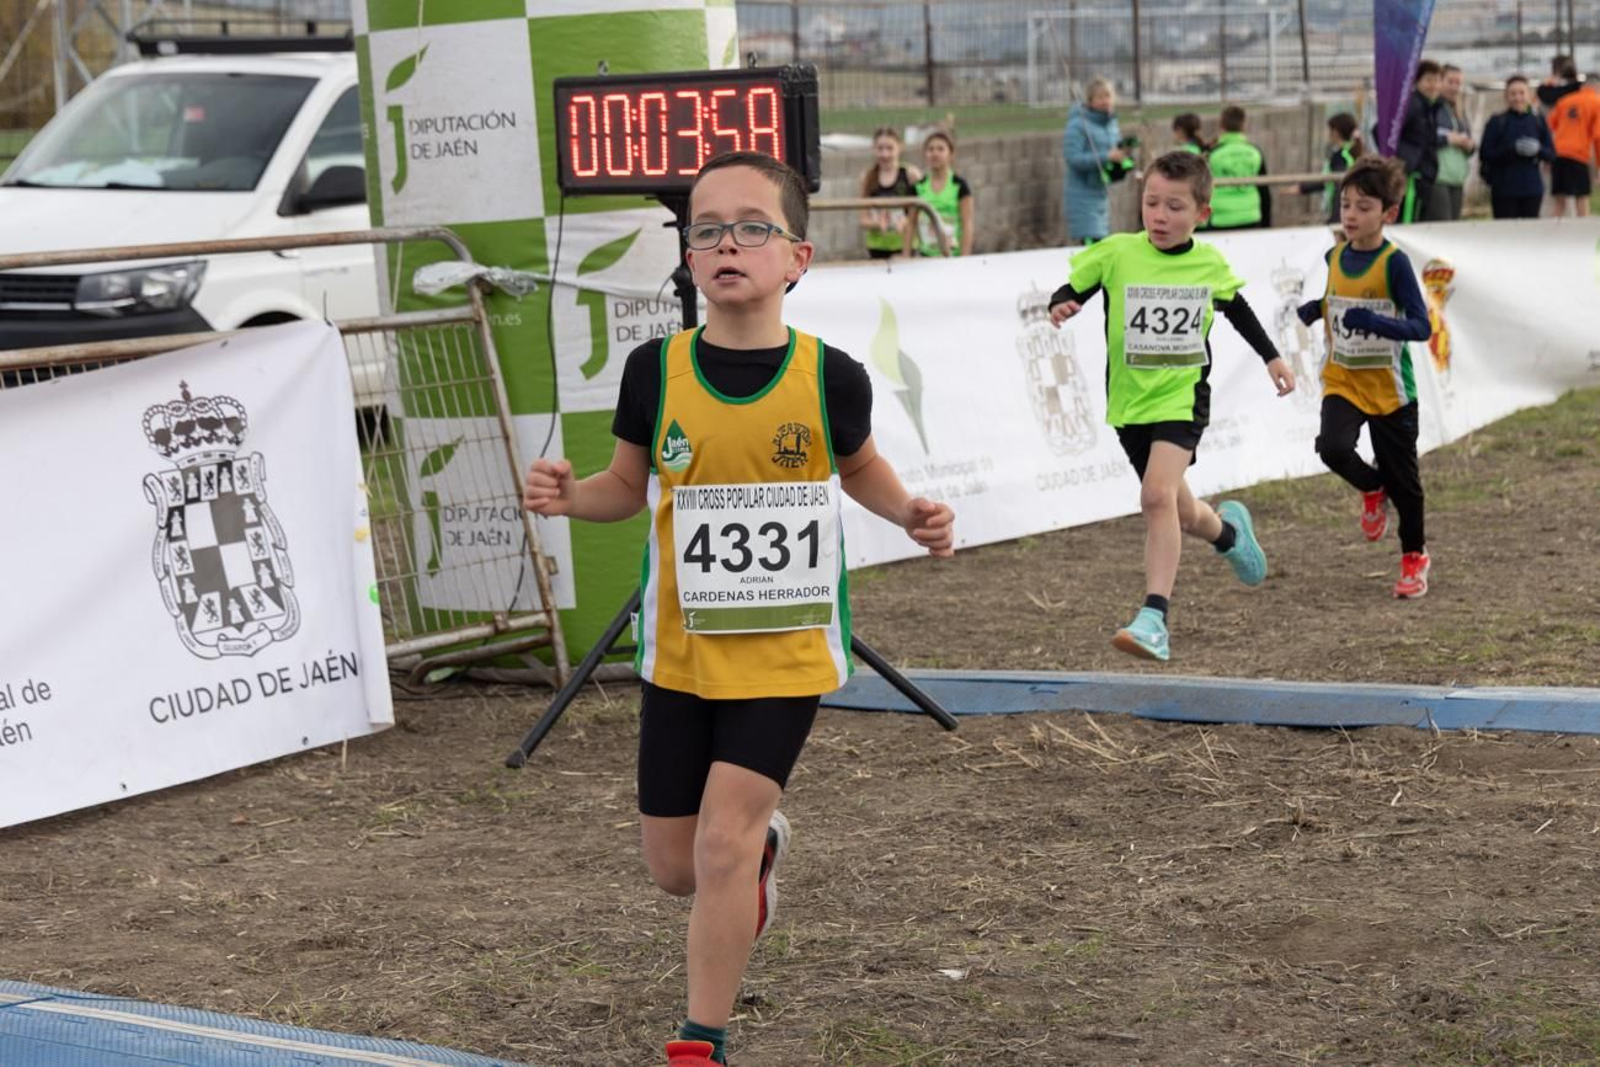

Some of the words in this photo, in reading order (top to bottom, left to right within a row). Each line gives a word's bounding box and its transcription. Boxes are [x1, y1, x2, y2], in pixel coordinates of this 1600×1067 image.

[409, 109, 516, 135] DIPUTACIÓN
[411, 143, 432, 160] DE
[434, 138, 478, 158] JAÉN
[1130, 306, 1202, 335] 4324
[616, 325, 642, 342] DE
[676, 489, 697, 511] XXVIII
[698, 488, 725, 510] CROSS
[727, 487, 765, 510] POPULAR
[766, 486, 796, 508] CIUDAD
[797, 485, 808, 507] DE
[810, 485, 829, 506] JAEN
[468, 526, 511, 547] JAÉN
[683, 520, 819, 574] 4331
[740, 576, 774, 584] ADRIAN
[683, 590, 755, 603] CARDENAS
[758, 586, 831, 600] HERRADOR
[22, 679, 51, 704] de
[149, 678, 252, 723] CIUDAD
[257, 667, 293, 697] DE
[299, 650, 358, 689] JAÉN
[0, 718, 32, 746] én
